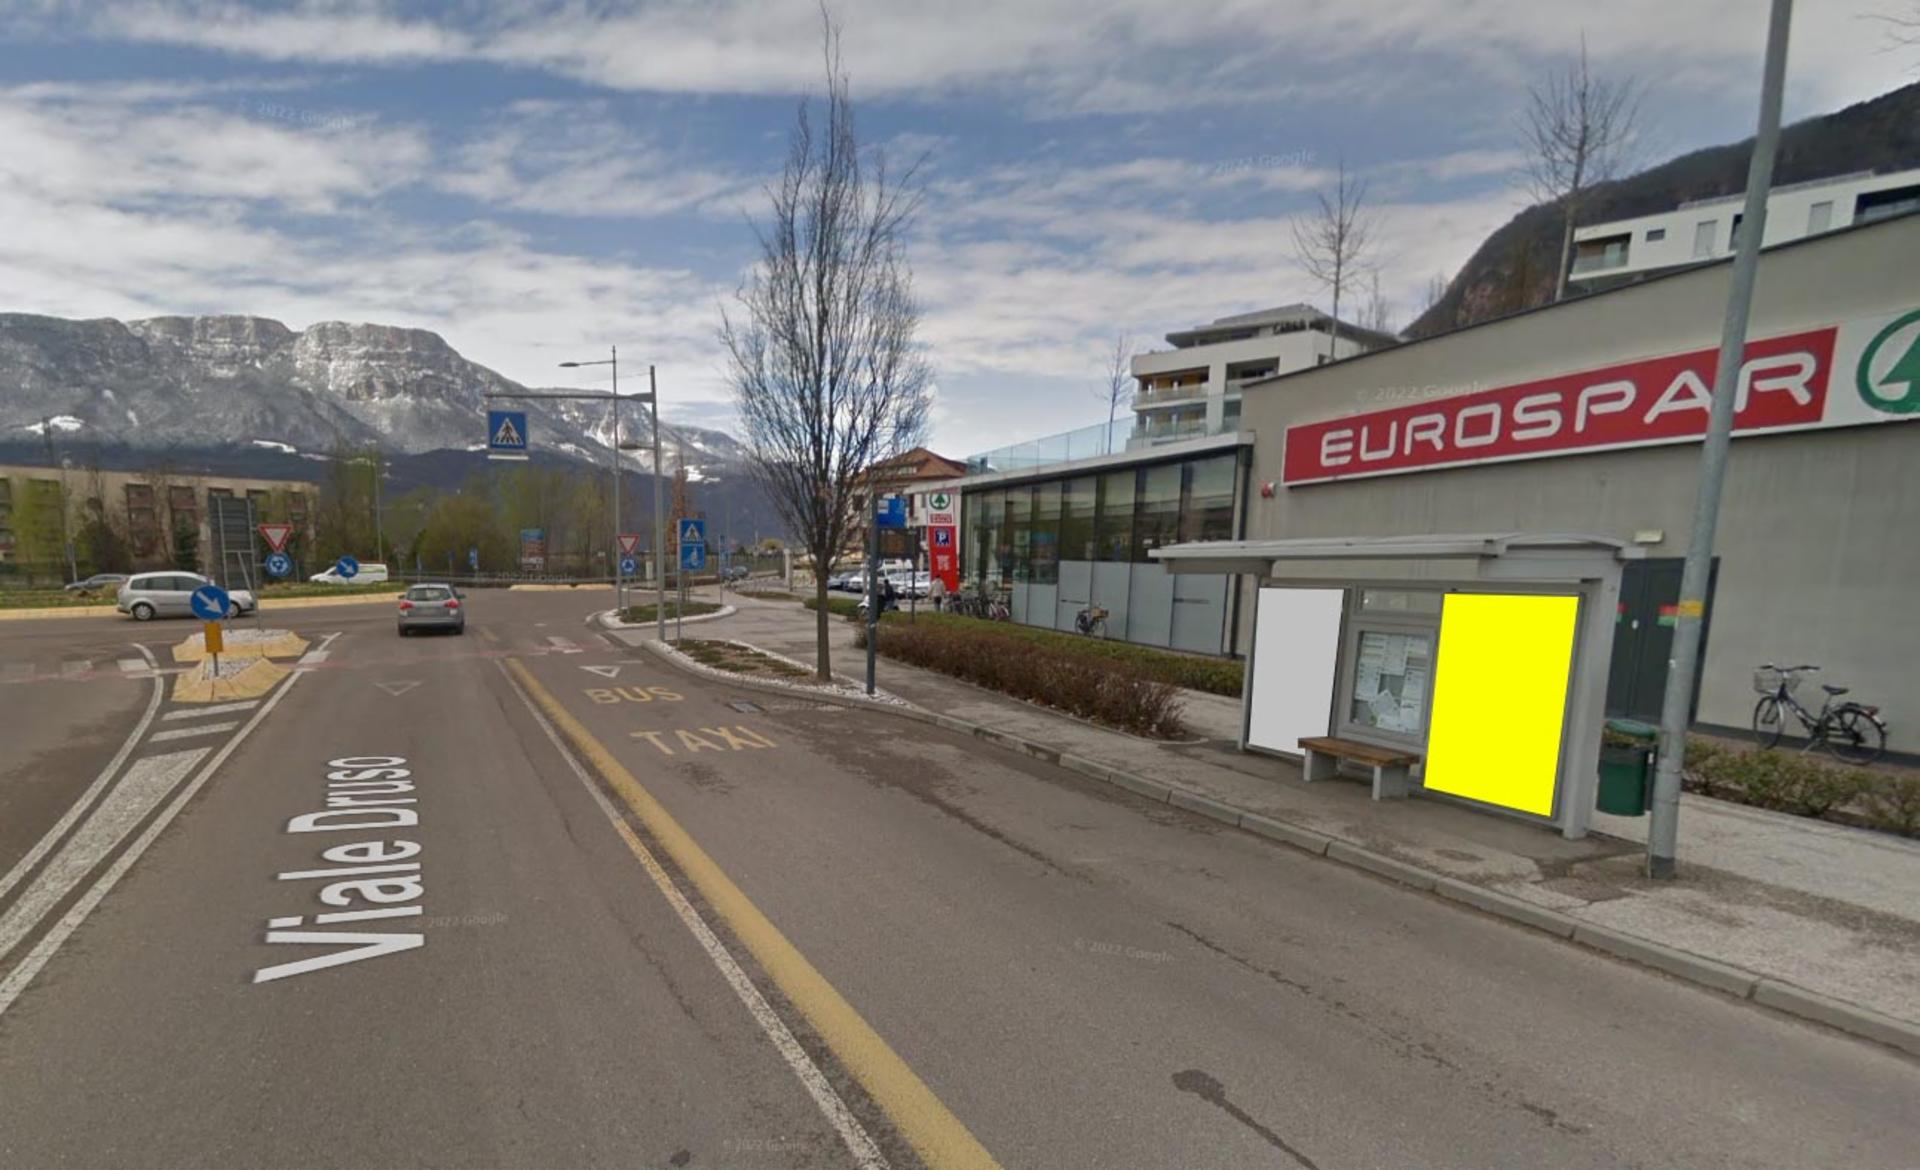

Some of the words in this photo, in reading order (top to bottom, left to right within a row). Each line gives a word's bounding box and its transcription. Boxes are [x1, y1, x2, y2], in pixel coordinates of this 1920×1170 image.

[1320, 351, 1818, 467] EUROSPAR
[583, 686, 685, 704] BUS
[629, 725, 779, 756] TAXI
